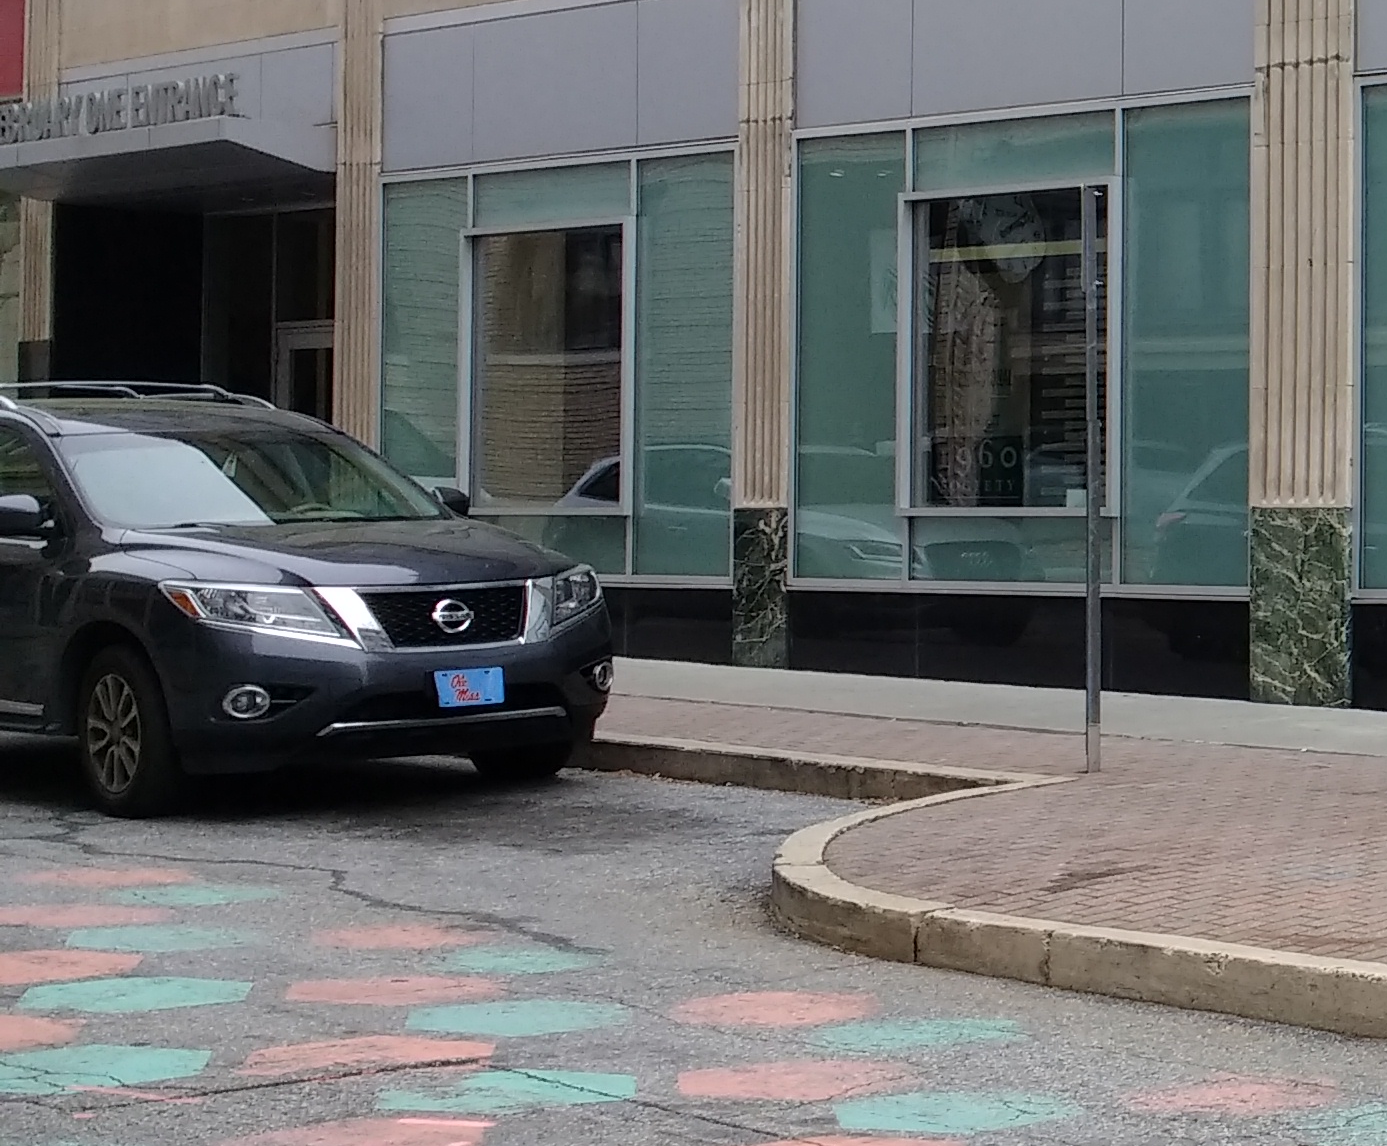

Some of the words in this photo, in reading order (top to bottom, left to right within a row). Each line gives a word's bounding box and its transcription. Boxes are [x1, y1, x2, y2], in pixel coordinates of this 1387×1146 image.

[85, 87, 130, 135] ONE
[130, 71, 240, 129] ENTRANCE
[454, 687, 482, 703] Miss
